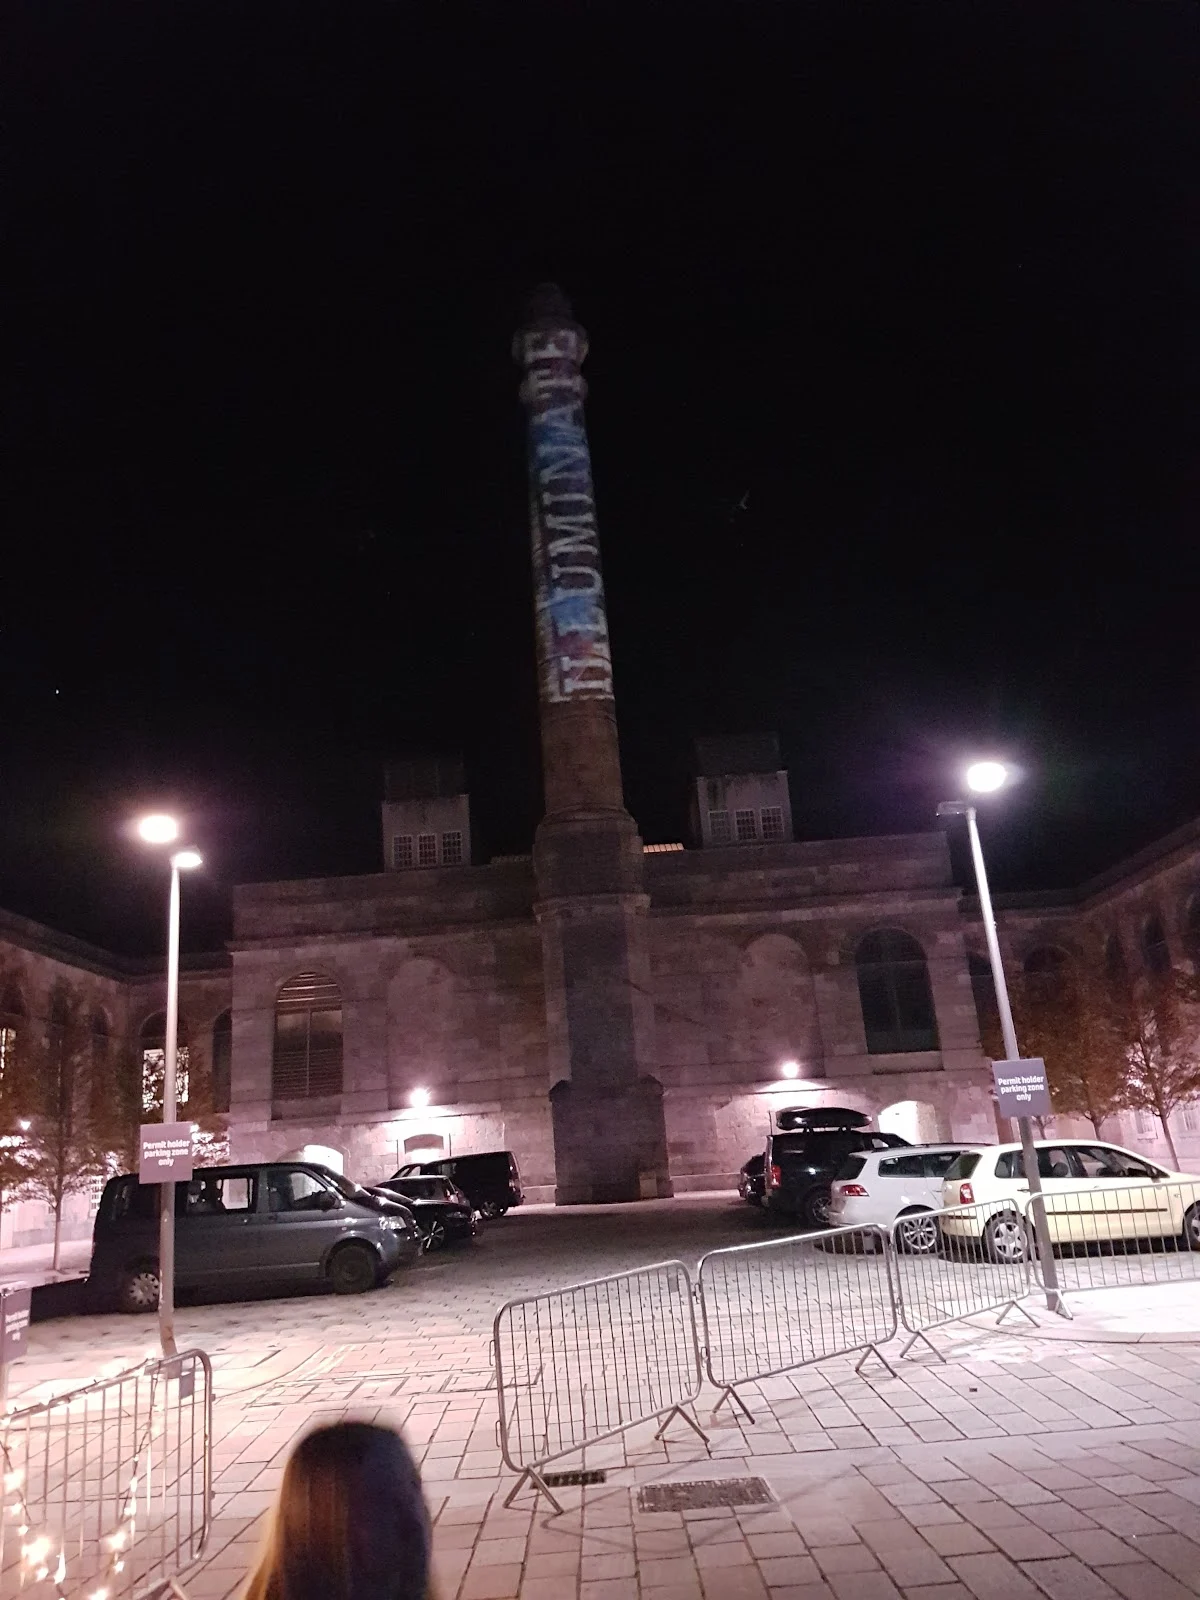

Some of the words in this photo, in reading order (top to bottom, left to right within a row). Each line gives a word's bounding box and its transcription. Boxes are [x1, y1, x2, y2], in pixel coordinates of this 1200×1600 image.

[523, 329, 612, 693] ILLUMINATE
[998, 1077, 1021, 1085] Permit
[1021, 1075, 1044, 1083] holder
[1000, 1085, 1027, 1094] parking
[1016, 1093, 1032, 1101] only
[143, 1141, 166, 1149] Permit
[167, 1140, 190, 1148] holder
[144, 1150, 171, 1159] parking
[158, 1158, 174, 1166] only
